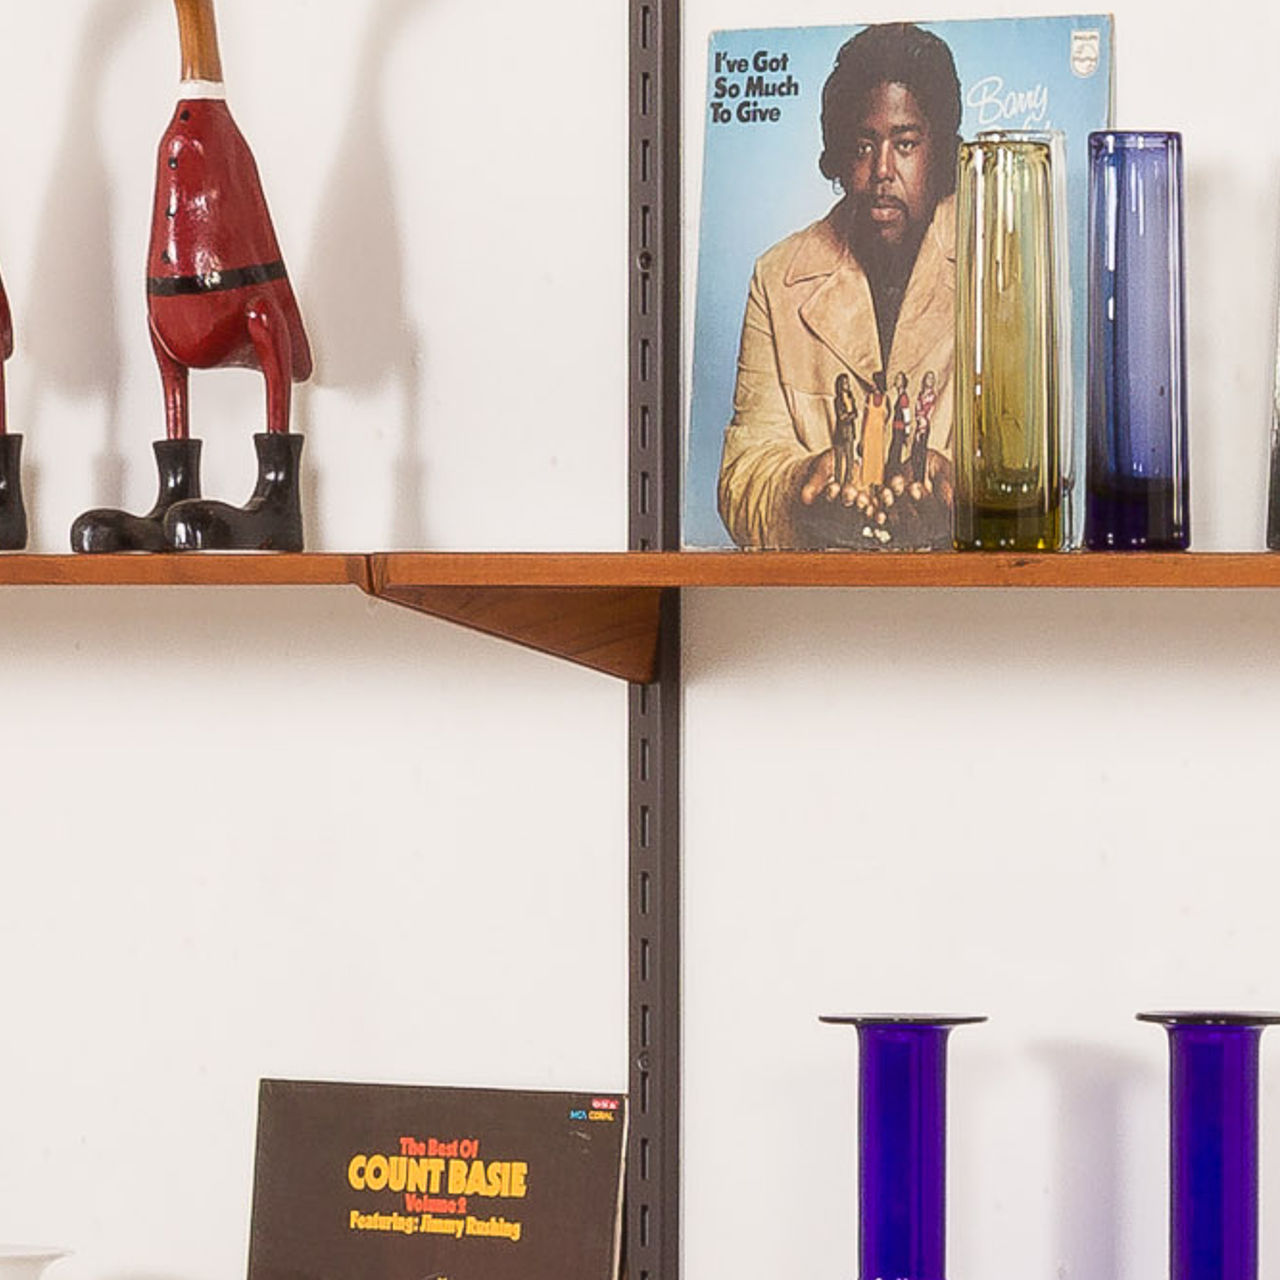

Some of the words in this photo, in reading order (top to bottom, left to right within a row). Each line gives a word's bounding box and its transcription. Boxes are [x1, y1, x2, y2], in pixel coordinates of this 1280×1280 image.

[715, 51, 749, 73] I've
[753, 50, 789, 72] Got
[714, 76, 740, 99] So
[745, 75, 799, 97] Much
[710, 101, 731, 123] To
[736, 100, 781, 123] Give
[400, 1136, 426, 1156] The
[428, 1138, 459, 1158] Best
[460, 1139, 479, 1159] Of
[348, 1154, 445, 1194] COUNT
[448, 1158, 528, 1198] BASIE
[405, 1193, 456, 1213] Volume
[457, 1197, 467, 1213] 2
[350, 1210, 418, 1234] Featuring:
[420, 1214, 464, 1238] Jimmy
[466, 1216, 522, 1241] Rushing
